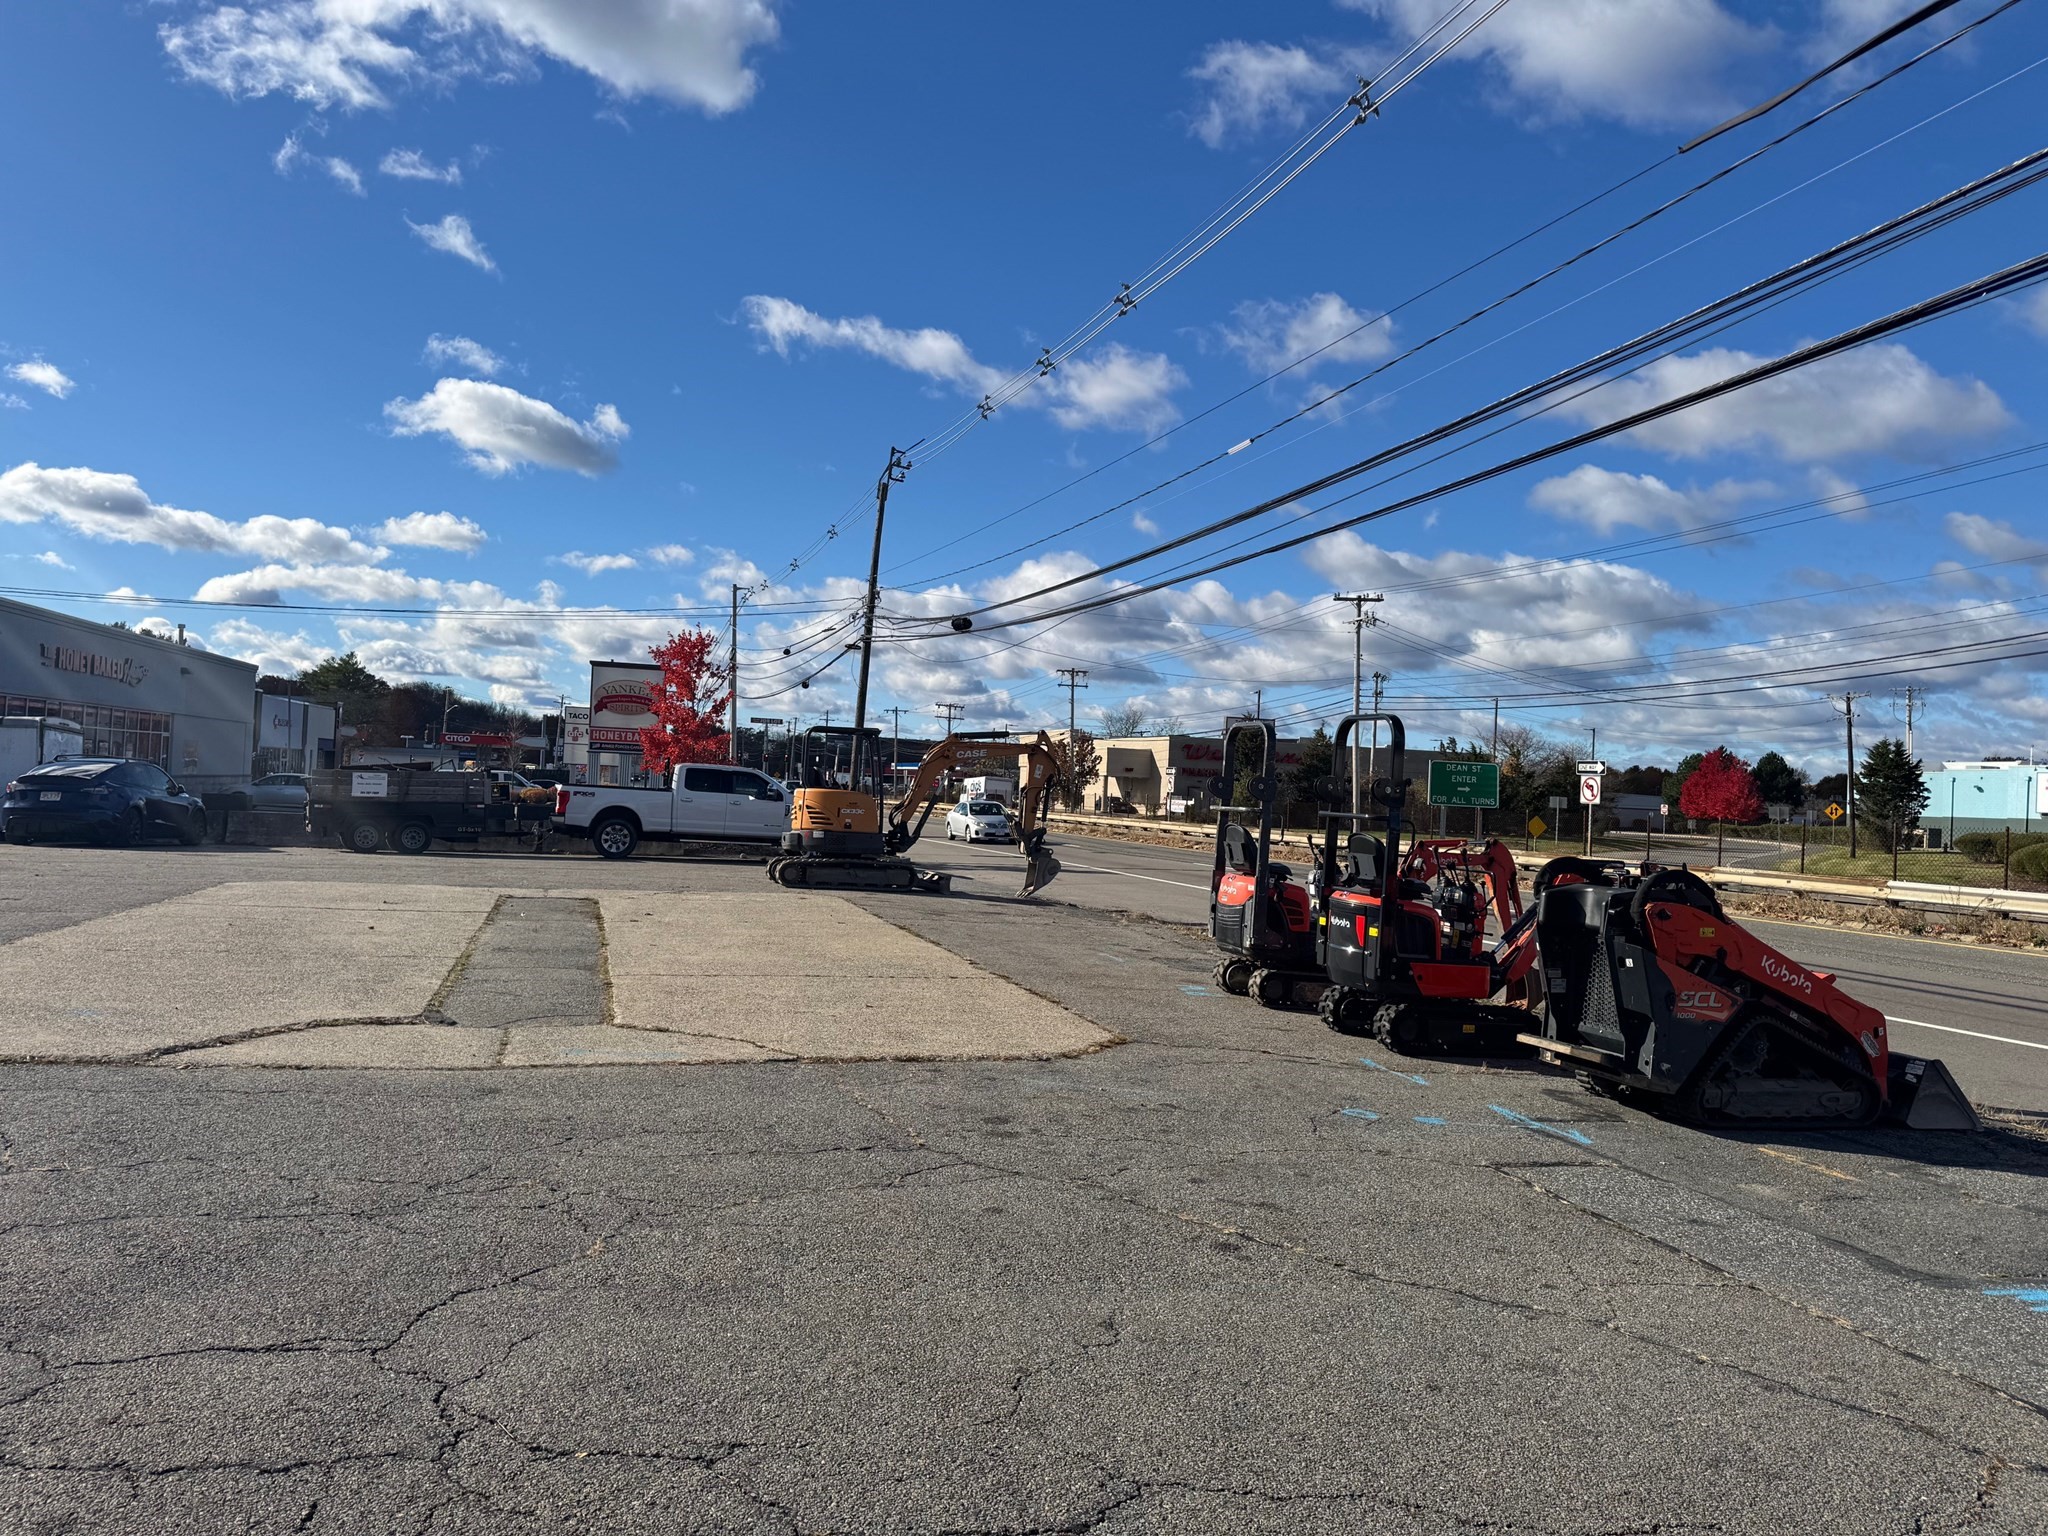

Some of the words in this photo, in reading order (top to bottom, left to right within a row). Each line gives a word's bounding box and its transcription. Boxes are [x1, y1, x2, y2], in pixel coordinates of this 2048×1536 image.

[57, 647, 93, 674] HONEY
[93, 655, 125, 680] BAKED
[609, 704, 645, 713] SPIRITS
[445, 735, 471, 743] CITGO
[956, 749, 988, 759] CASE
[1446, 764, 1468, 772] DEAN
[1451, 775, 1477, 783] ENTER
[1432, 795, 1447, 803] FOR
[1451, 796, 1466, 804] ALL
[1471, 797, 1495, 805] TURNS
[1761, 954, 1813, 995] Kubota
[1678, 991, 1723, 1008] SCL
